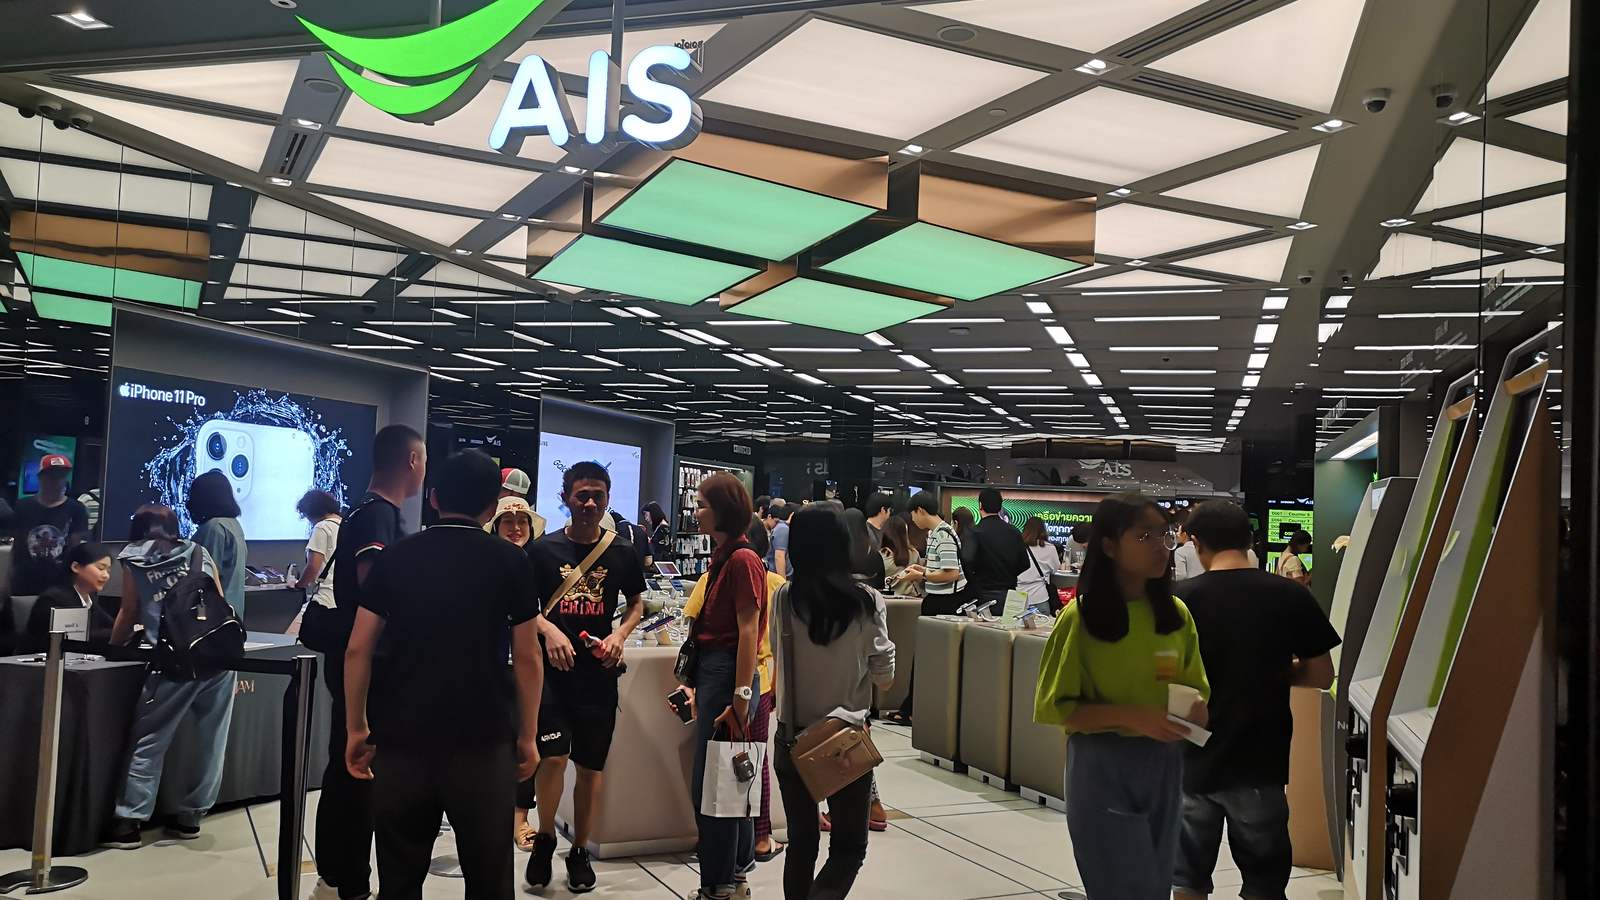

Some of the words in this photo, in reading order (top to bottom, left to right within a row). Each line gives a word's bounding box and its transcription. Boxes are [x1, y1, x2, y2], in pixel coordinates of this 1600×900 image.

[489, 45, 692, 149] AIS
[130, 383, 173, 402] iPhone
[174, 389, 185, 404] 11
[186, 390, 206, 407] Pro
[559, 599, 604, 616] CHINA
